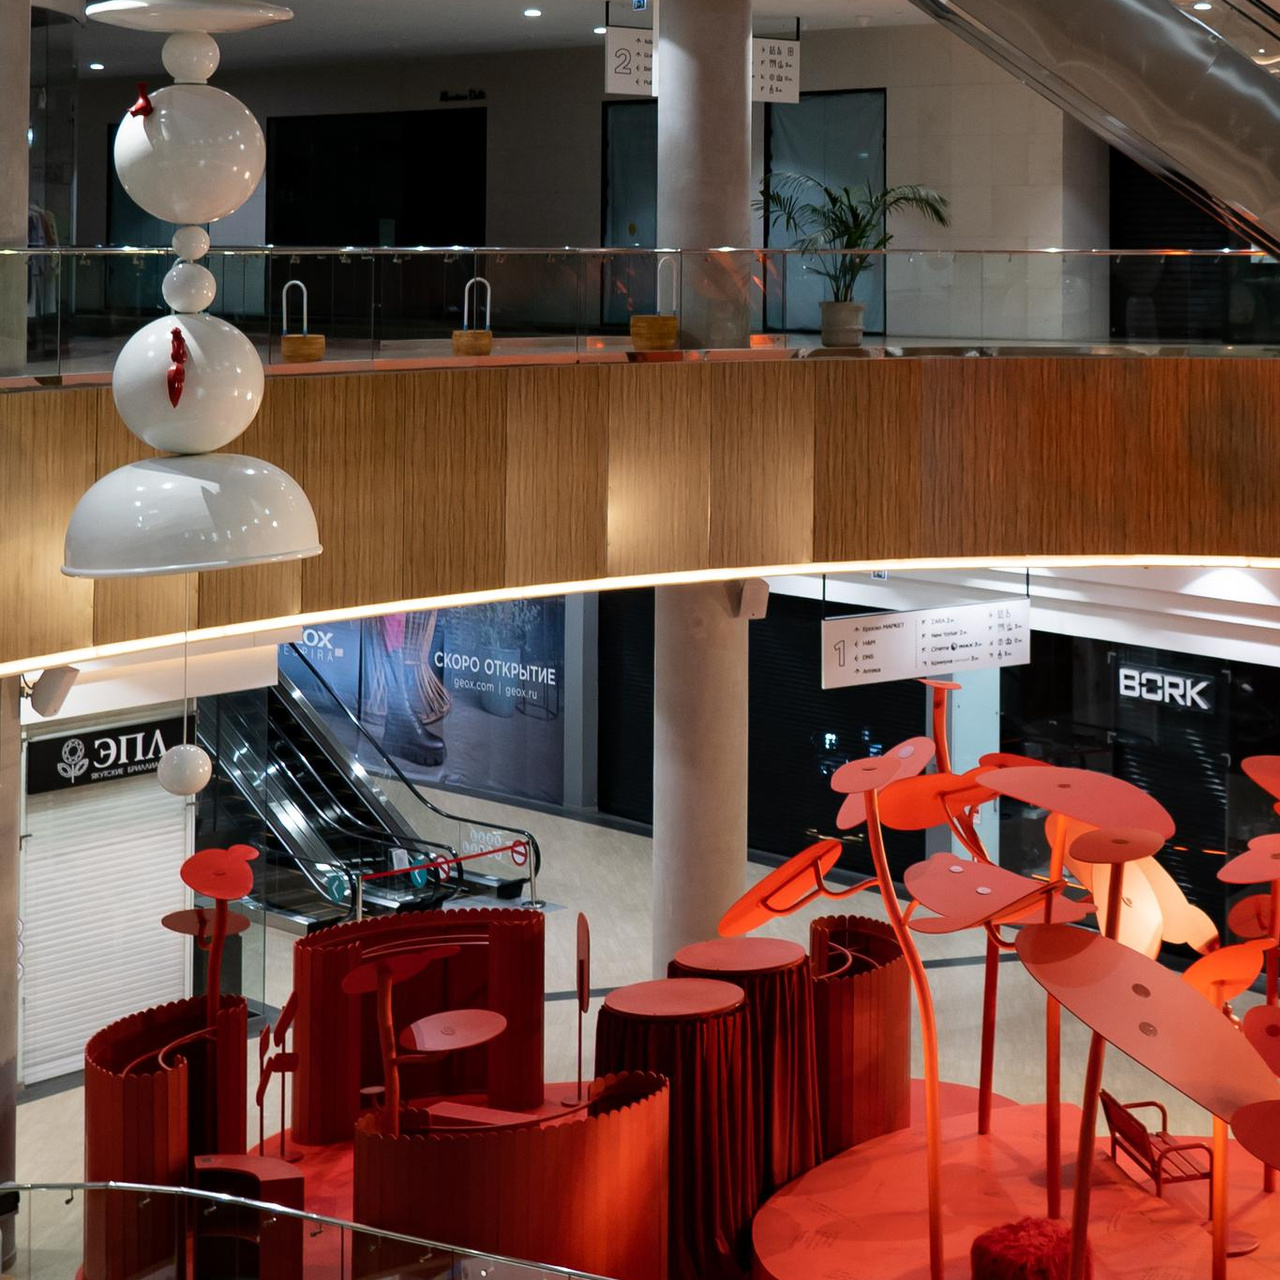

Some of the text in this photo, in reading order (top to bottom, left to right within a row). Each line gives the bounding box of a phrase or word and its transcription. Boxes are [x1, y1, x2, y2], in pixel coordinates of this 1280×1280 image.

[614, 47, 632, 75] 2
[297, 629, 334, 650] OX
[834, 639, 846, 668] 1
[434, 651, 556, 686] СКОРО ОТКРЫТИЕ
[453, 676, 538, 700] geox.com geox.ru
[1119, 668, 1211, 710] BORK
[93, 729, 167, 768] ЭПЛ
